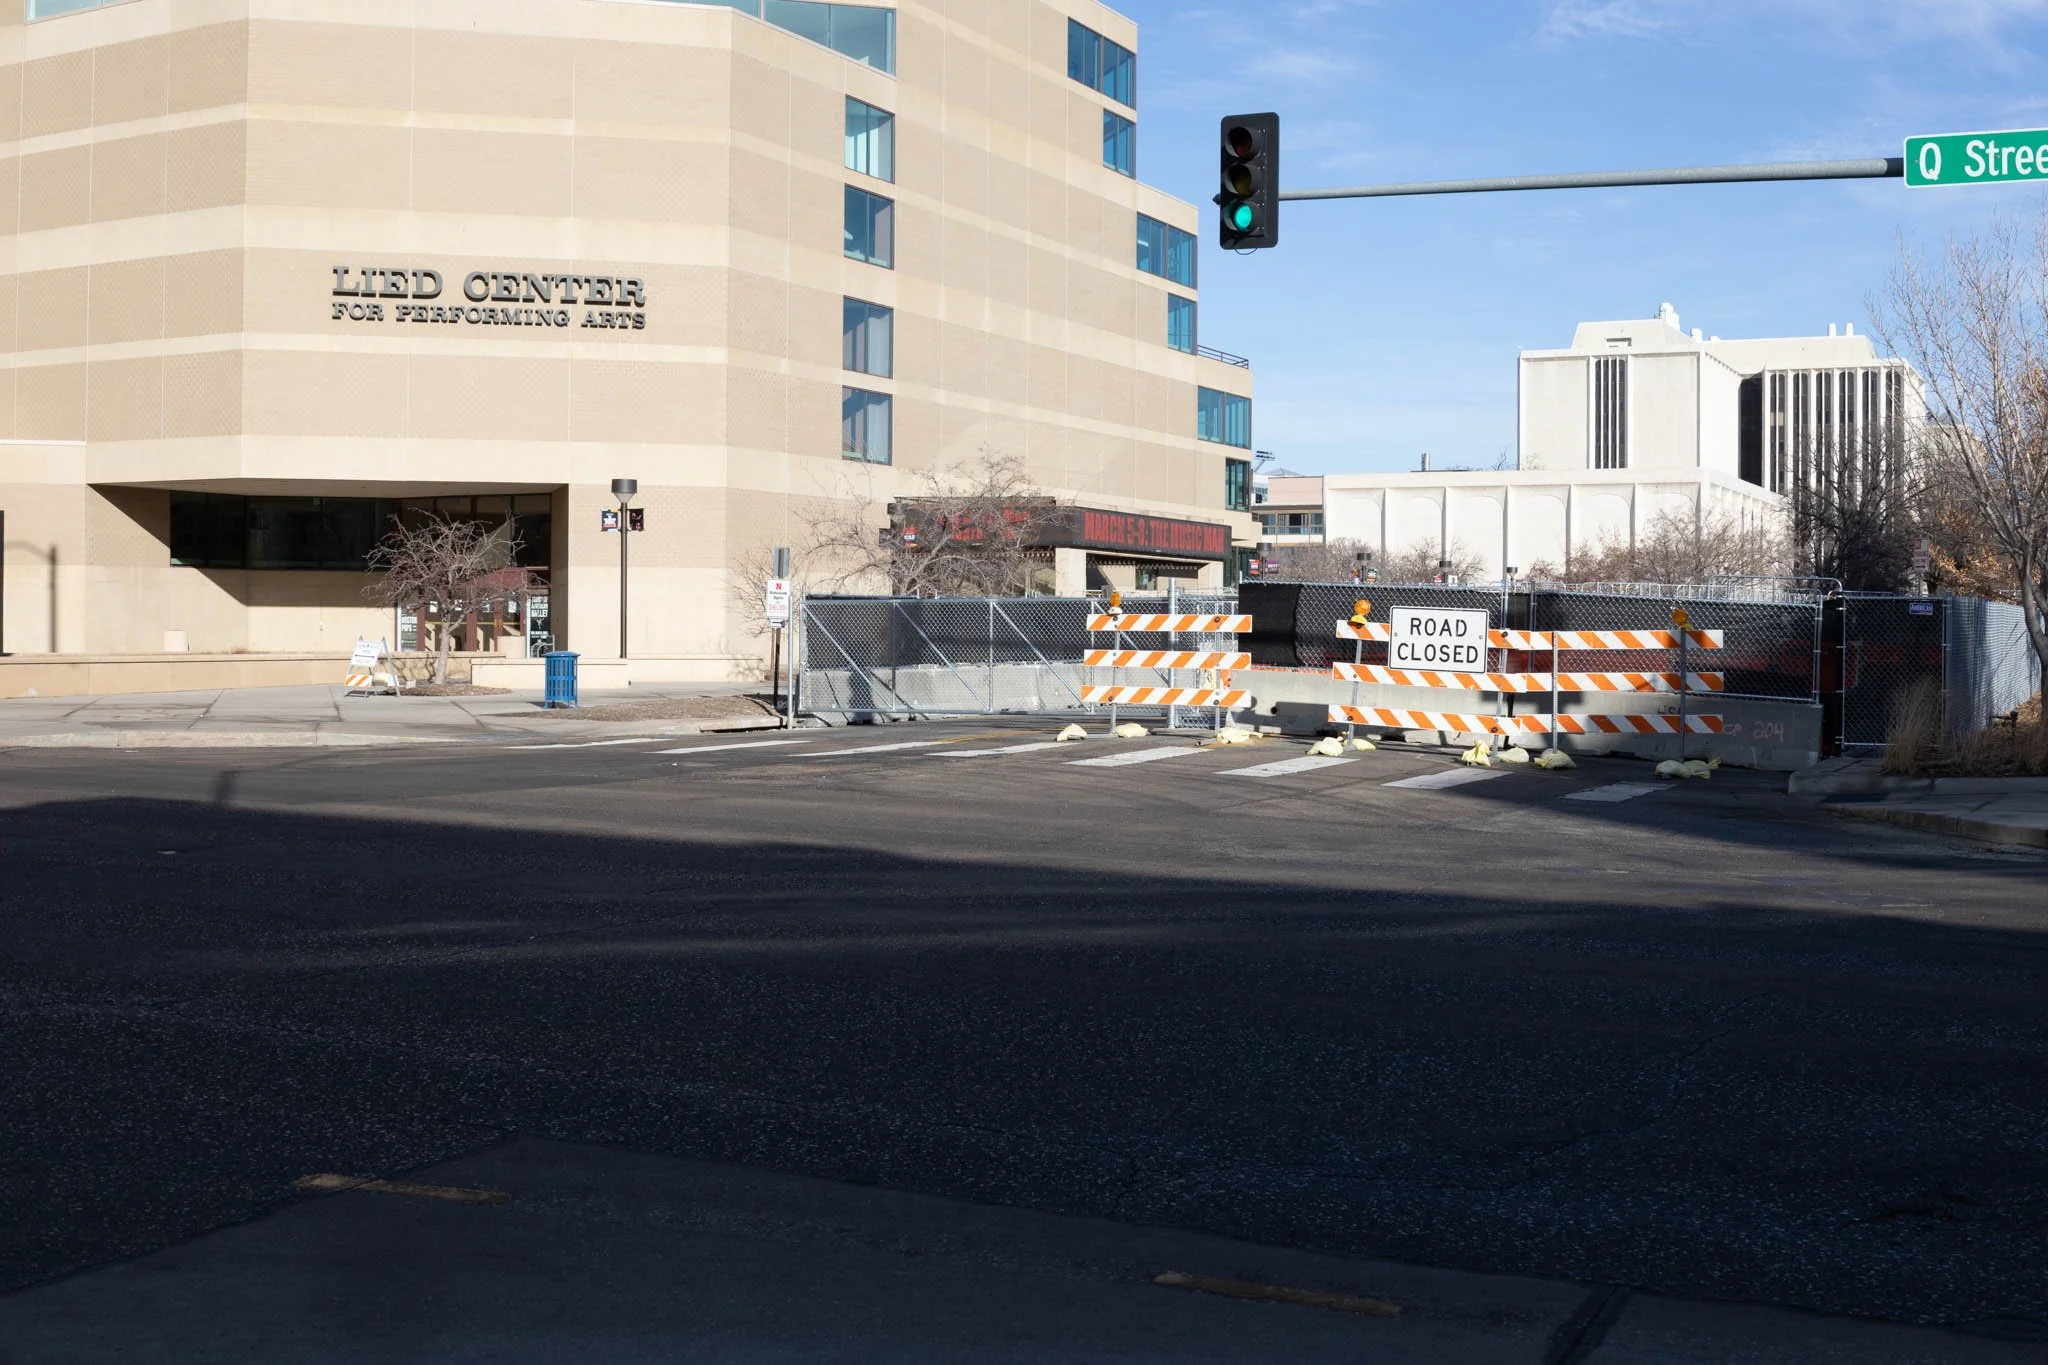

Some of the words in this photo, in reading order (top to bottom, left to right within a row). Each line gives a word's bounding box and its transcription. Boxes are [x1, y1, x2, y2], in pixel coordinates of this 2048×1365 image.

[1919, 142, 1942, 181] Q
[332, 265, 443, 300] LIED
[463, 271, 648, 308] CENTER
[331, 302, 384, 322] FOR
[395, 304, 571, 328] PERFORMING
[581, 311, 647, 330] ARTS
[1084, 511, 1124, 543] MARCH
[1150, 520, 1168, 548] THE
[1171, 523, 1202, 551] MUSIC
[1203, 527, 1224, 553] MAN
[775, 582, 782, 590] N
[1410, 618, 1468, 637] ROAD
[1397, 643, 1479, 664] CLOSED
